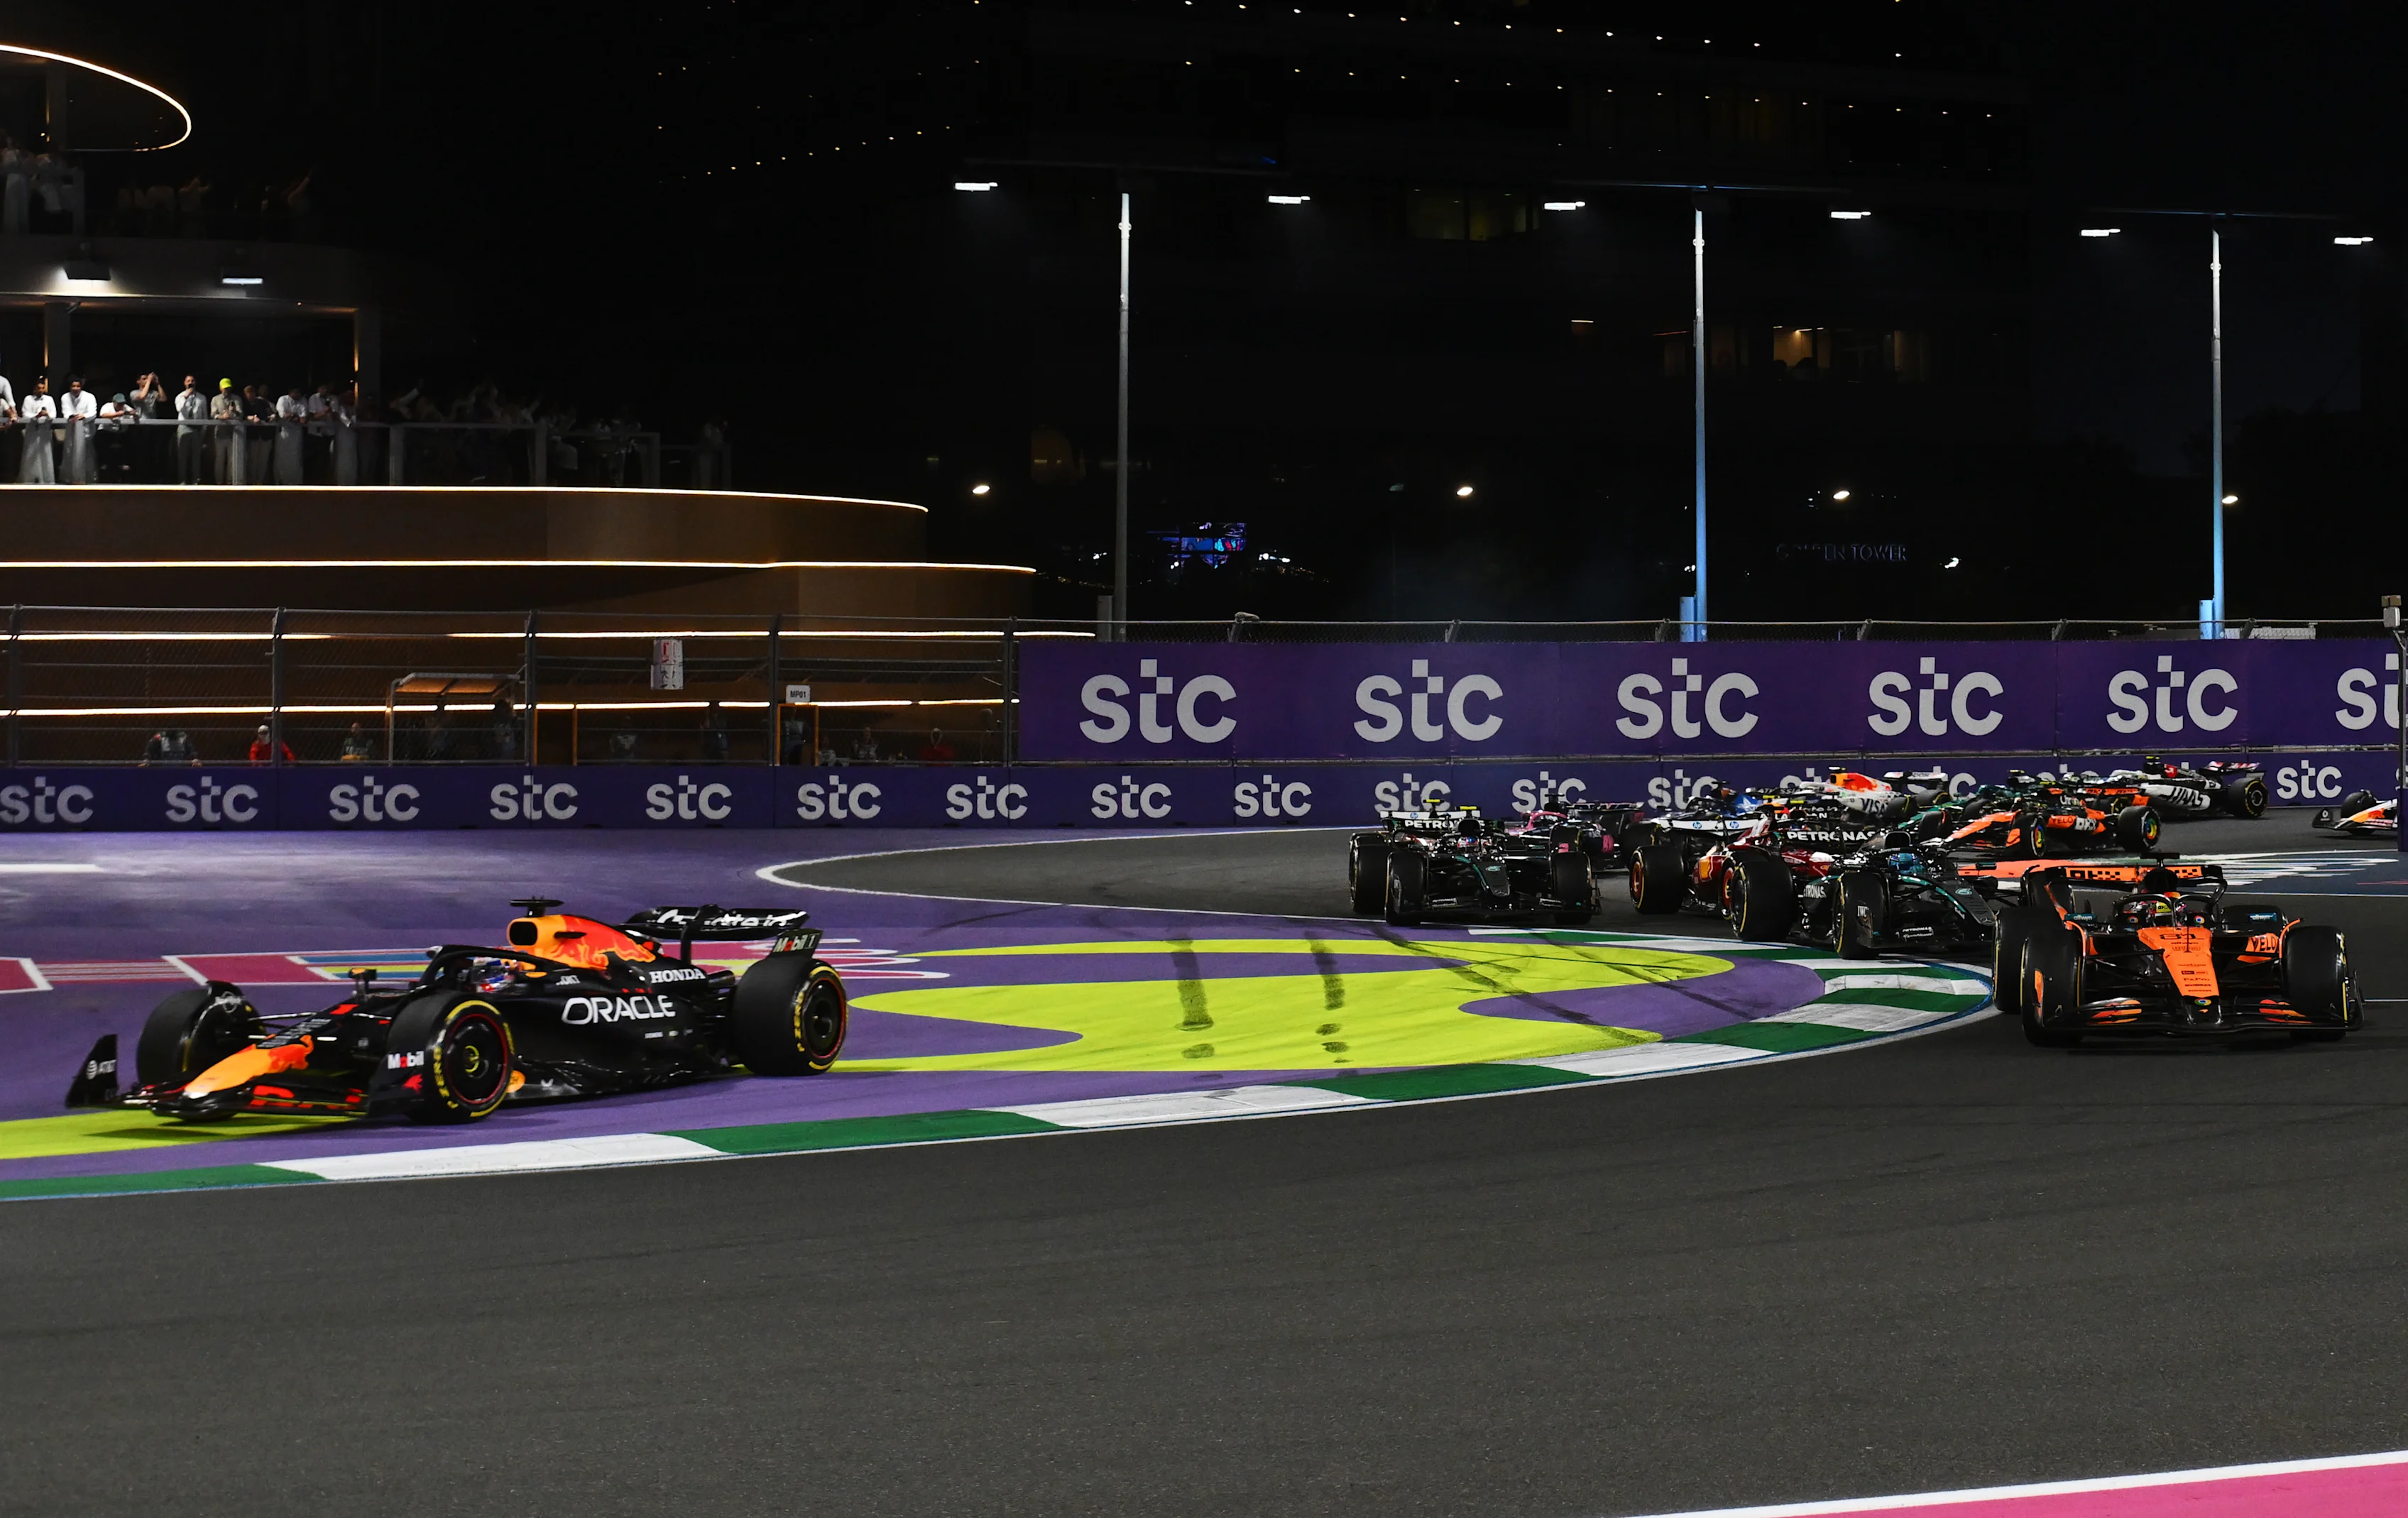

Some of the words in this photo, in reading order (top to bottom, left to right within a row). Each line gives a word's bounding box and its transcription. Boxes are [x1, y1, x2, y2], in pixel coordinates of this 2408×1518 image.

[1850, 543, 1908, 562] TOWER
[789, 690, 806, 699] MP01
[1079, 659, 1237, 743] stc
[1354, 659, 1504, 743] stc
[1616, 658, 1759, 740] stc
[1868, 657, 2004, 736] stc
[2107, 655, 2238, 733] stc
[0, 776, 94, 824] stc
[167, 776, 258, 821] stc
[329, 776, 420, 821] stc
[490, 775, 578, 821] stc
[647, 775, 732, 819] stc
[797, 775, 882, 819] stc
[946, 775, 1028, 819] stc
[1092, 775, 1171, 819] stc
[1235, 775, 1312, 817] stc
[1374, 772, 1451, 812] stc
[2277, 759, 2342, 799] stc
[772, 937, 805, 953] Mobil
[2251, 936, 2278, 951] VELO
[649, 968, 706, 984] HONDA
[561, 995, 676, 1025] ORACLE
[387, 1050, 425, 1070] Mobil
